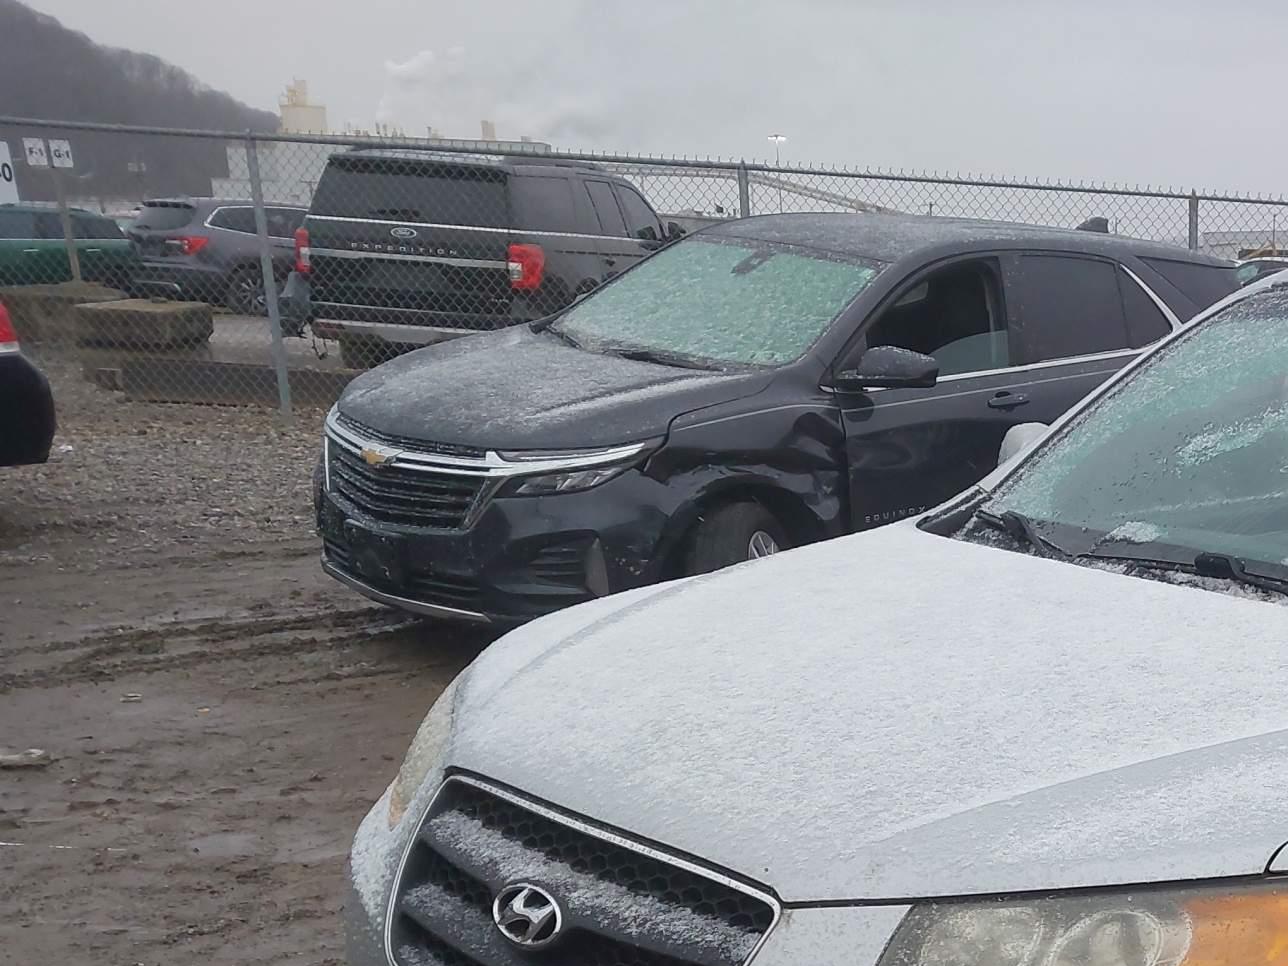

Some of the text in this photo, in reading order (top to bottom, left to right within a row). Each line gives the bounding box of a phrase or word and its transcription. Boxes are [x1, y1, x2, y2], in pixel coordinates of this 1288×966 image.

[53, 149, 70, 159] G-1
[351, 242, 457, 255] EXPEDITION
[865, 505, 925, 523] EQUINOX
